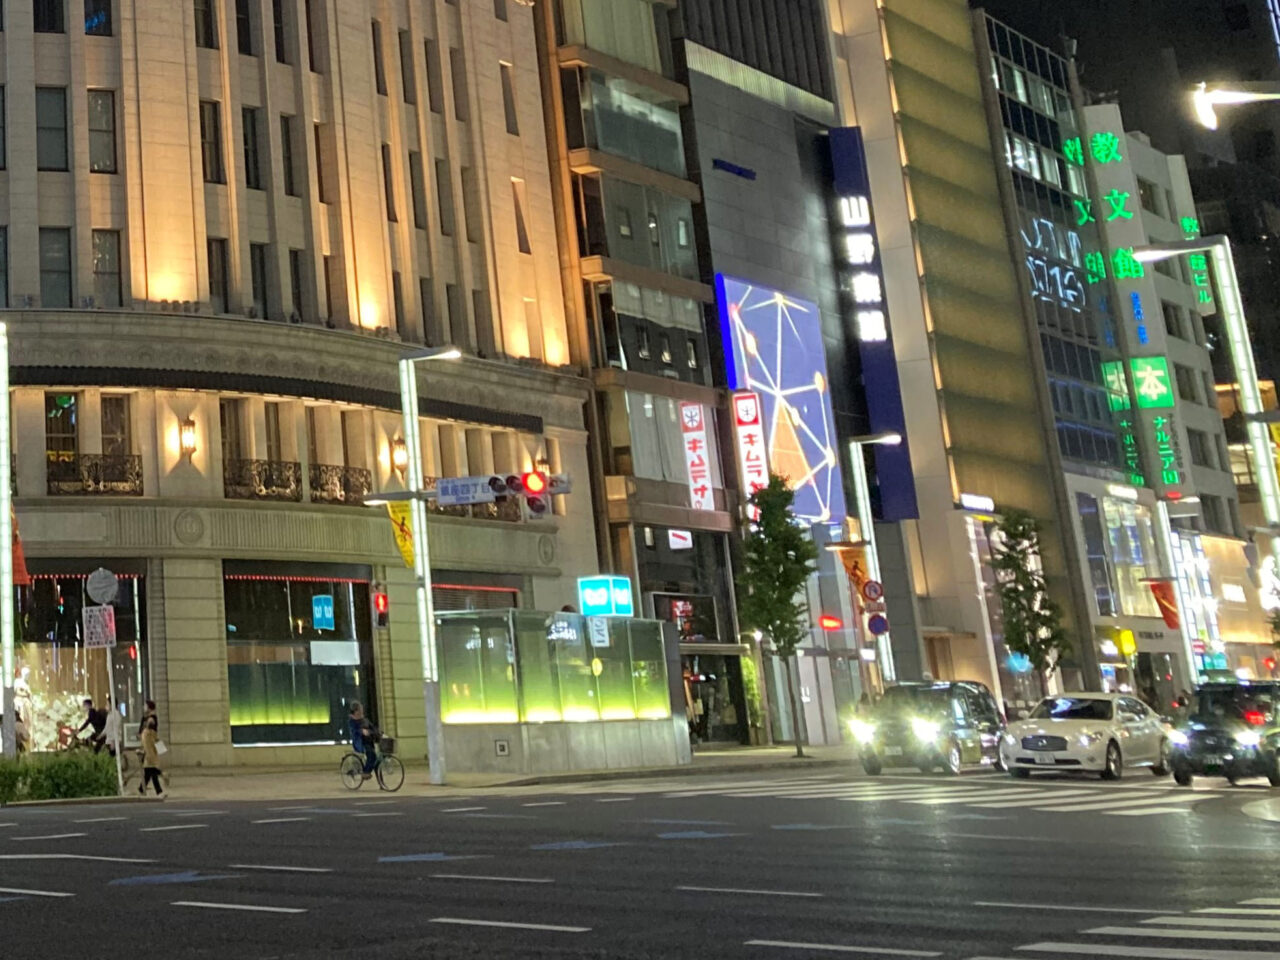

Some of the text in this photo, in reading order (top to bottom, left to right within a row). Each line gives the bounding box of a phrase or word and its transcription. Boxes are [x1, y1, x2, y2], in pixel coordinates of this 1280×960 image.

[1091, 131, 1145, 280] 教文館
[1180, 215, 1212, 304] 教館ビル
[1134, 365, 1168, 401] 本
[1153, 415, 1180, 485] ナルニア国
